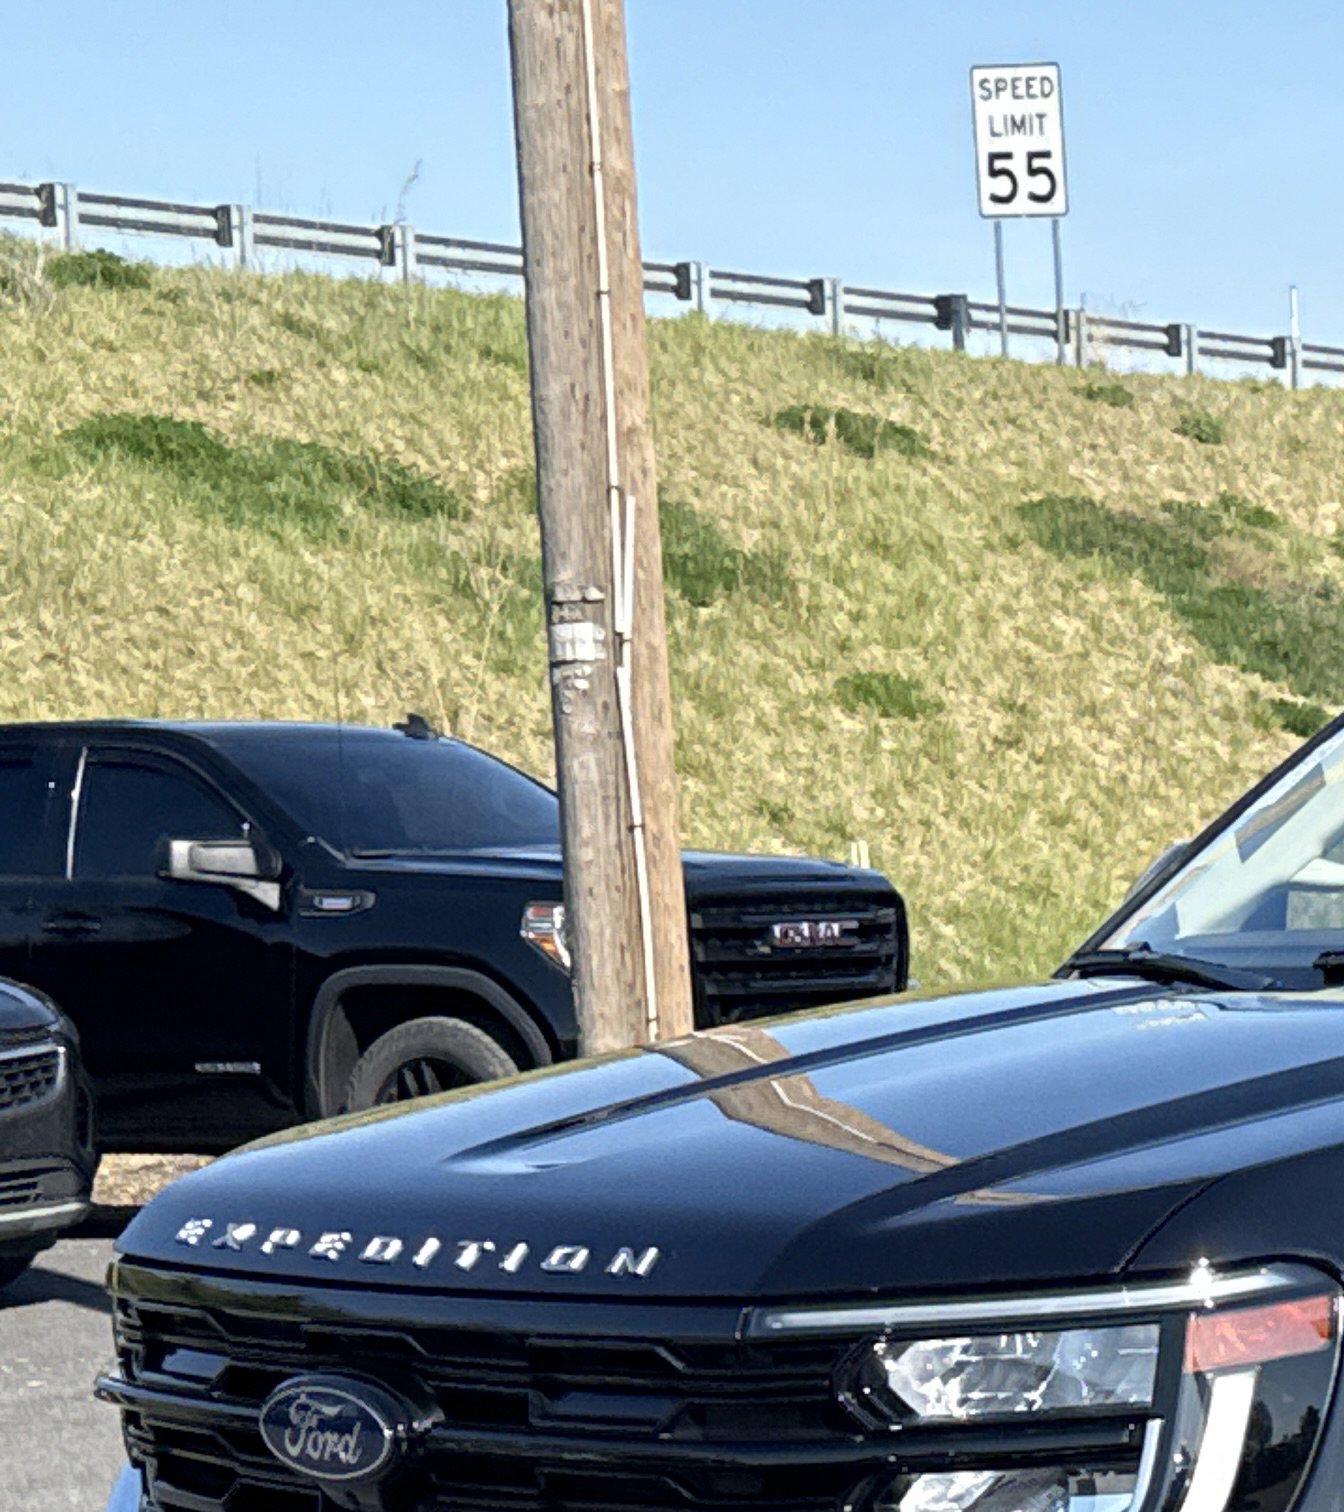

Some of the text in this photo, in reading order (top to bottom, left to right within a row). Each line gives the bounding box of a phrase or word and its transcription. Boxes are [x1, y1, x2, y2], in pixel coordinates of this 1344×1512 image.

[978, 75, 1055, 102] SPEED
[988, 112, 1048, 138] LIMIT
[987, 150, 1057, 205] 55
[772, 920, 860, 947] GMC
[174, 1217, 660, 1278] EXPEDITION
[284, 1393, 363, 1465] Ford
